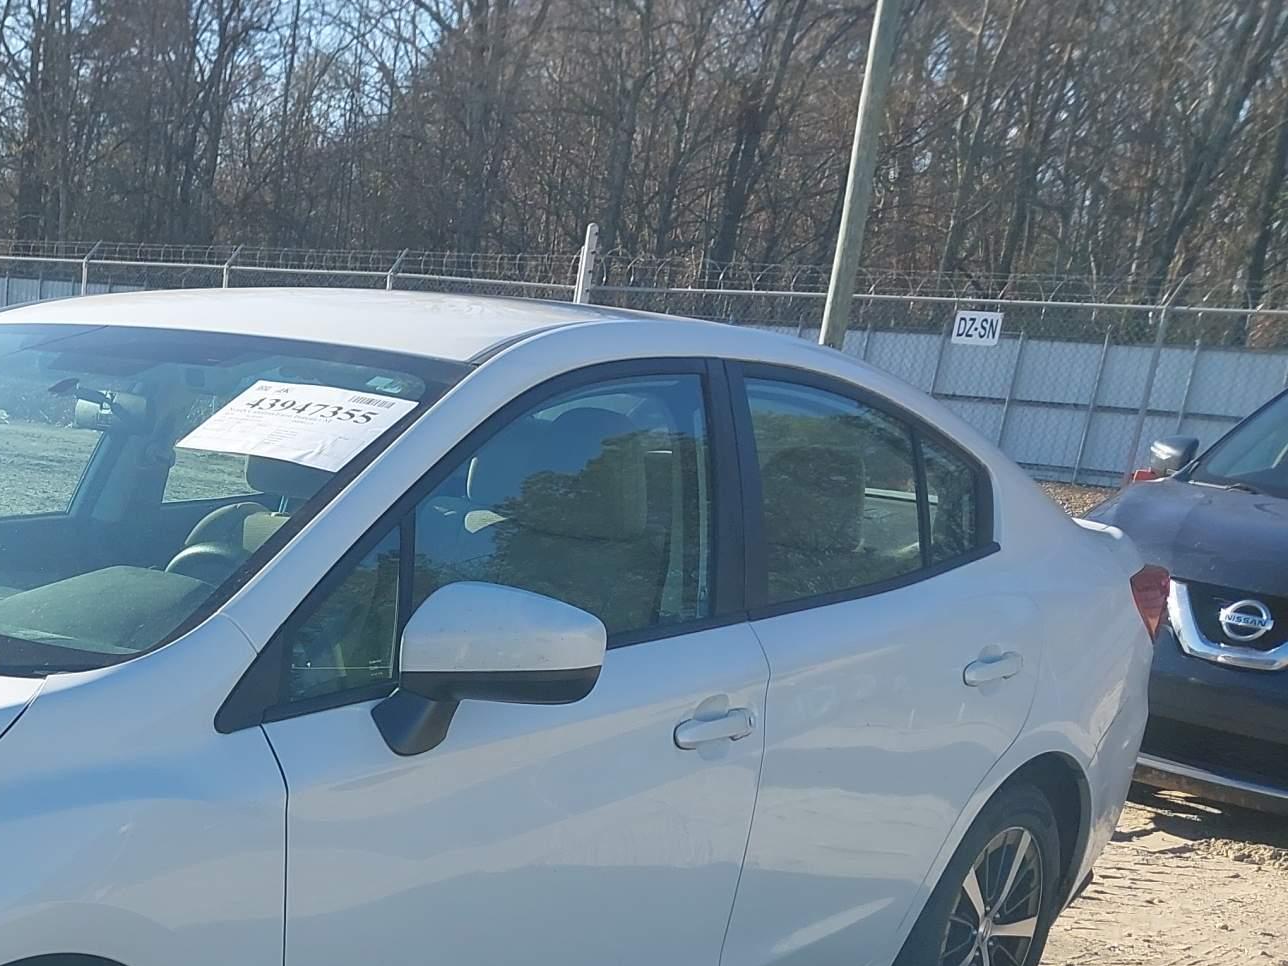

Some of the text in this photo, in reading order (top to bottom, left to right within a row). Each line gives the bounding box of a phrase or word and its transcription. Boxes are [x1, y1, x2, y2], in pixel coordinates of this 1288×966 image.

[956, 317, 999, 339] DZ-SN
[246, 397, 380, 425] 43947355
[1225, 614, 1267, 627] NISSAN
